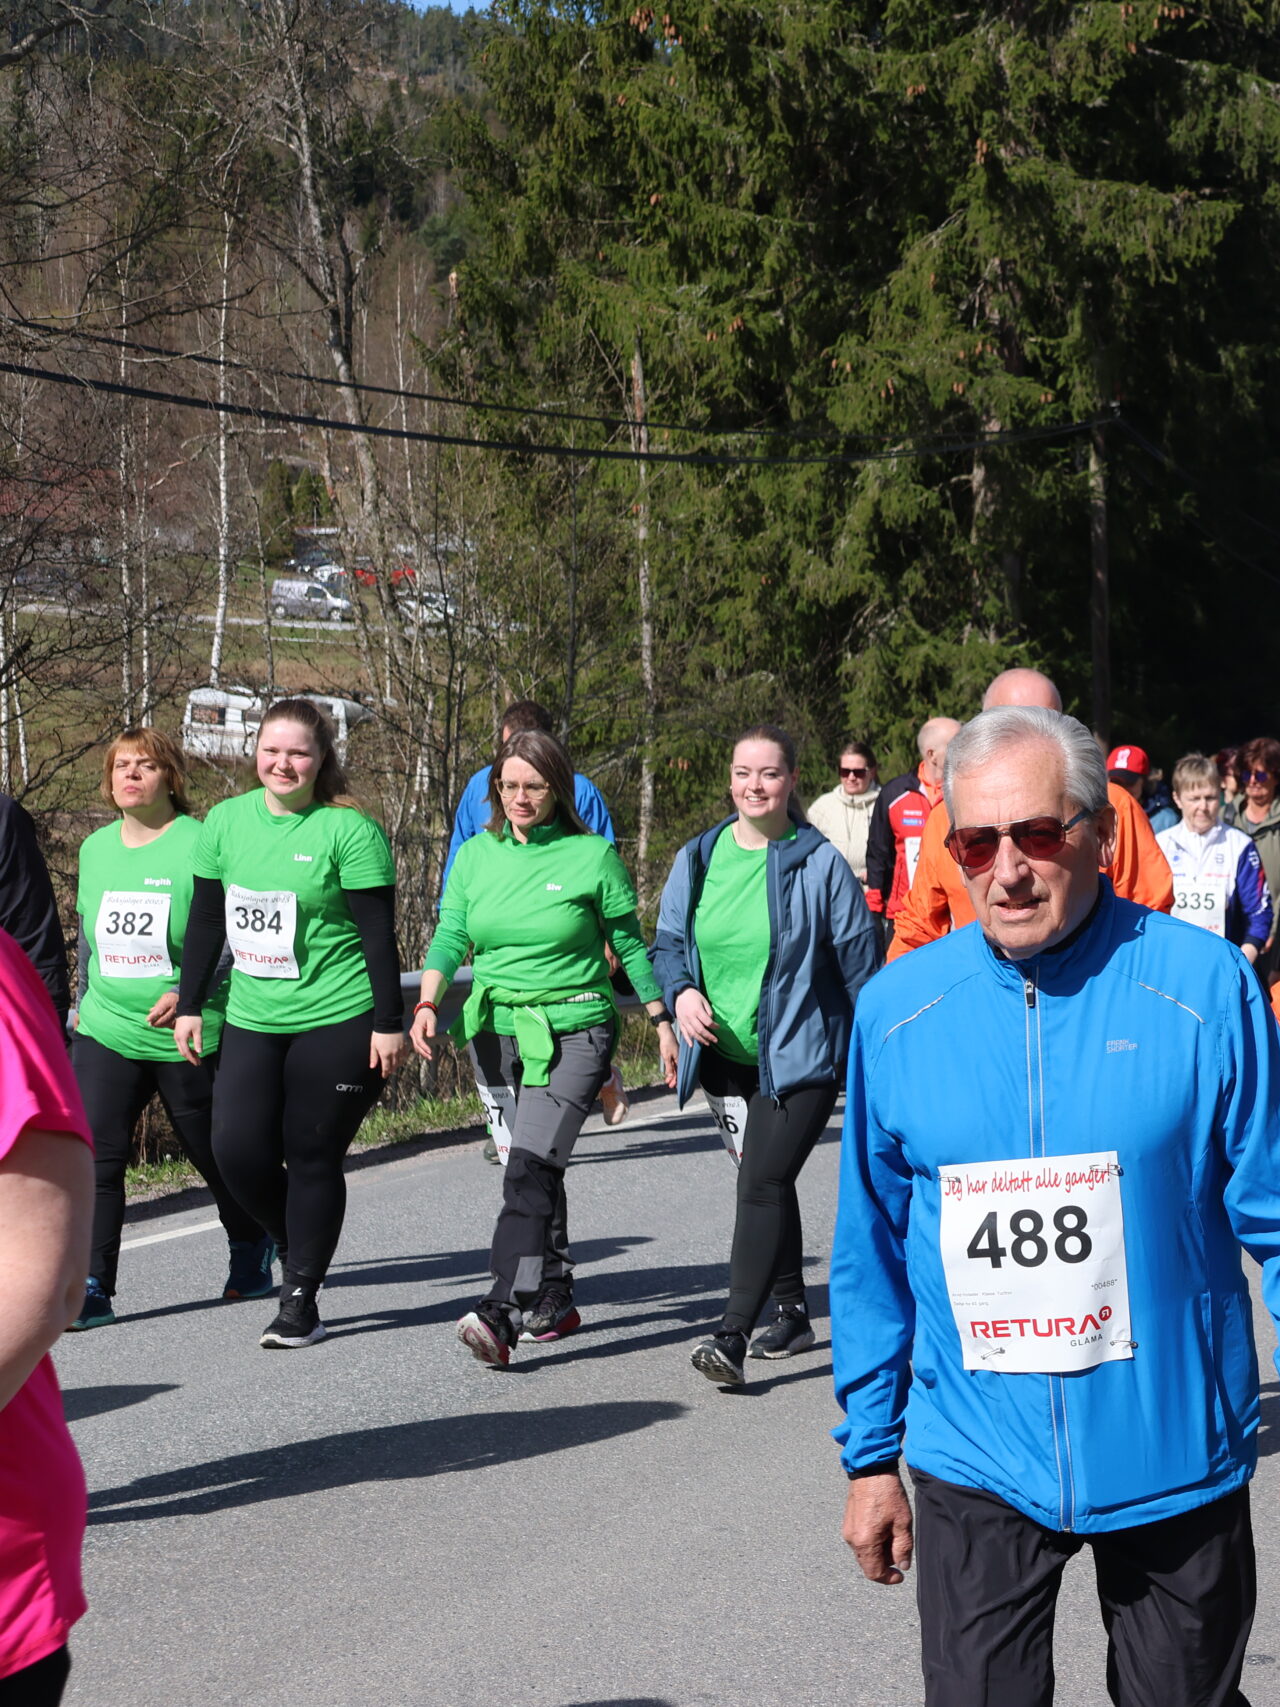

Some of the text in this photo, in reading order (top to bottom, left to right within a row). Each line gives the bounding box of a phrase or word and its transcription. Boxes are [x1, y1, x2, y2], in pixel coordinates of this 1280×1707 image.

[1177, 892, 1215, 910] 335
[105, 911, 154, 937] 382
[235, 906, 283, 935] 384
[105, 954, 158, 965] RETURA
[235, 948, 283, 964] RETURA
[944, 1162, 1111, 1201] Jeg har deltatt alle ganger!
[967, 1204, 1093, 1269] 488
[970, 1313, 1102, 1338] RETURA
